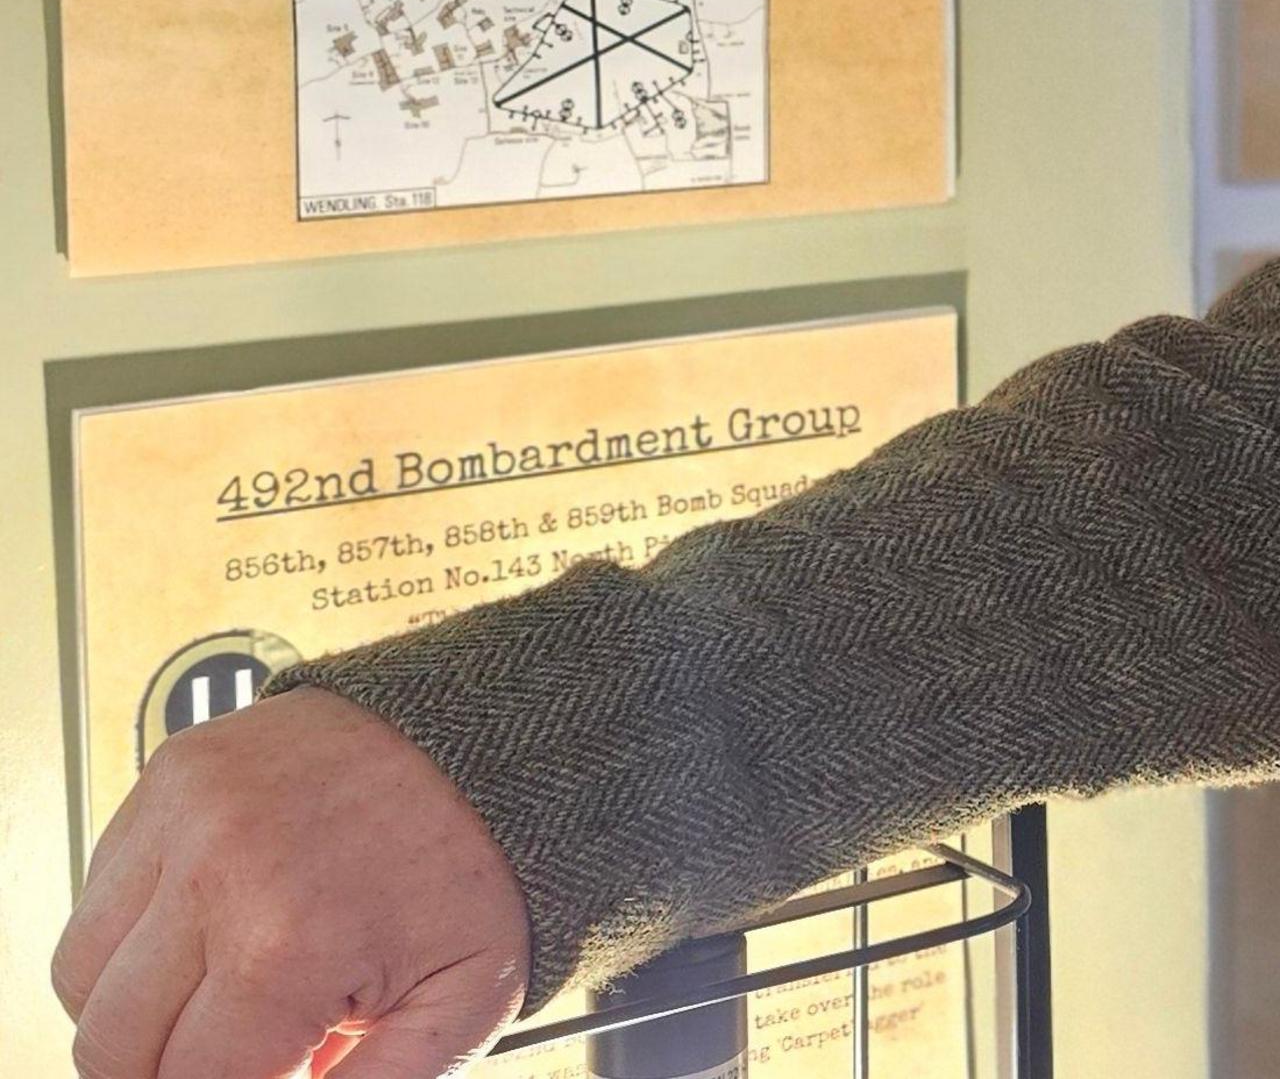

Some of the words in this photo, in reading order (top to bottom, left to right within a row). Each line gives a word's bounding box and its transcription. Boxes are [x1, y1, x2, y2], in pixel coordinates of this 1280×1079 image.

[303, 196, 376, 214] WENDLING
[412, 191, 432, 206] 118
[217, 459, 378, 514] 492nd
[396, 415, 712, 491] Bombardment
[728, 402, 862, 442] Group
[226, 549, 326, 582] 856th,
[338, 533, 434, 565] 857th,
[445, 516, 528, 549] 858th
[539, 511, 557, 534] &
[567, 499, 647, 530] 859th
[657, 488, 722, 517] Bomb
[312, 576, 434, 611] Station
[445, 554, 541, 591] No.143
[754, 1008, 800, 1030] take
[807, 993, 854, 1017] over
[867, 983, 895, 1001] he
[901, 970, 946, 994] role
